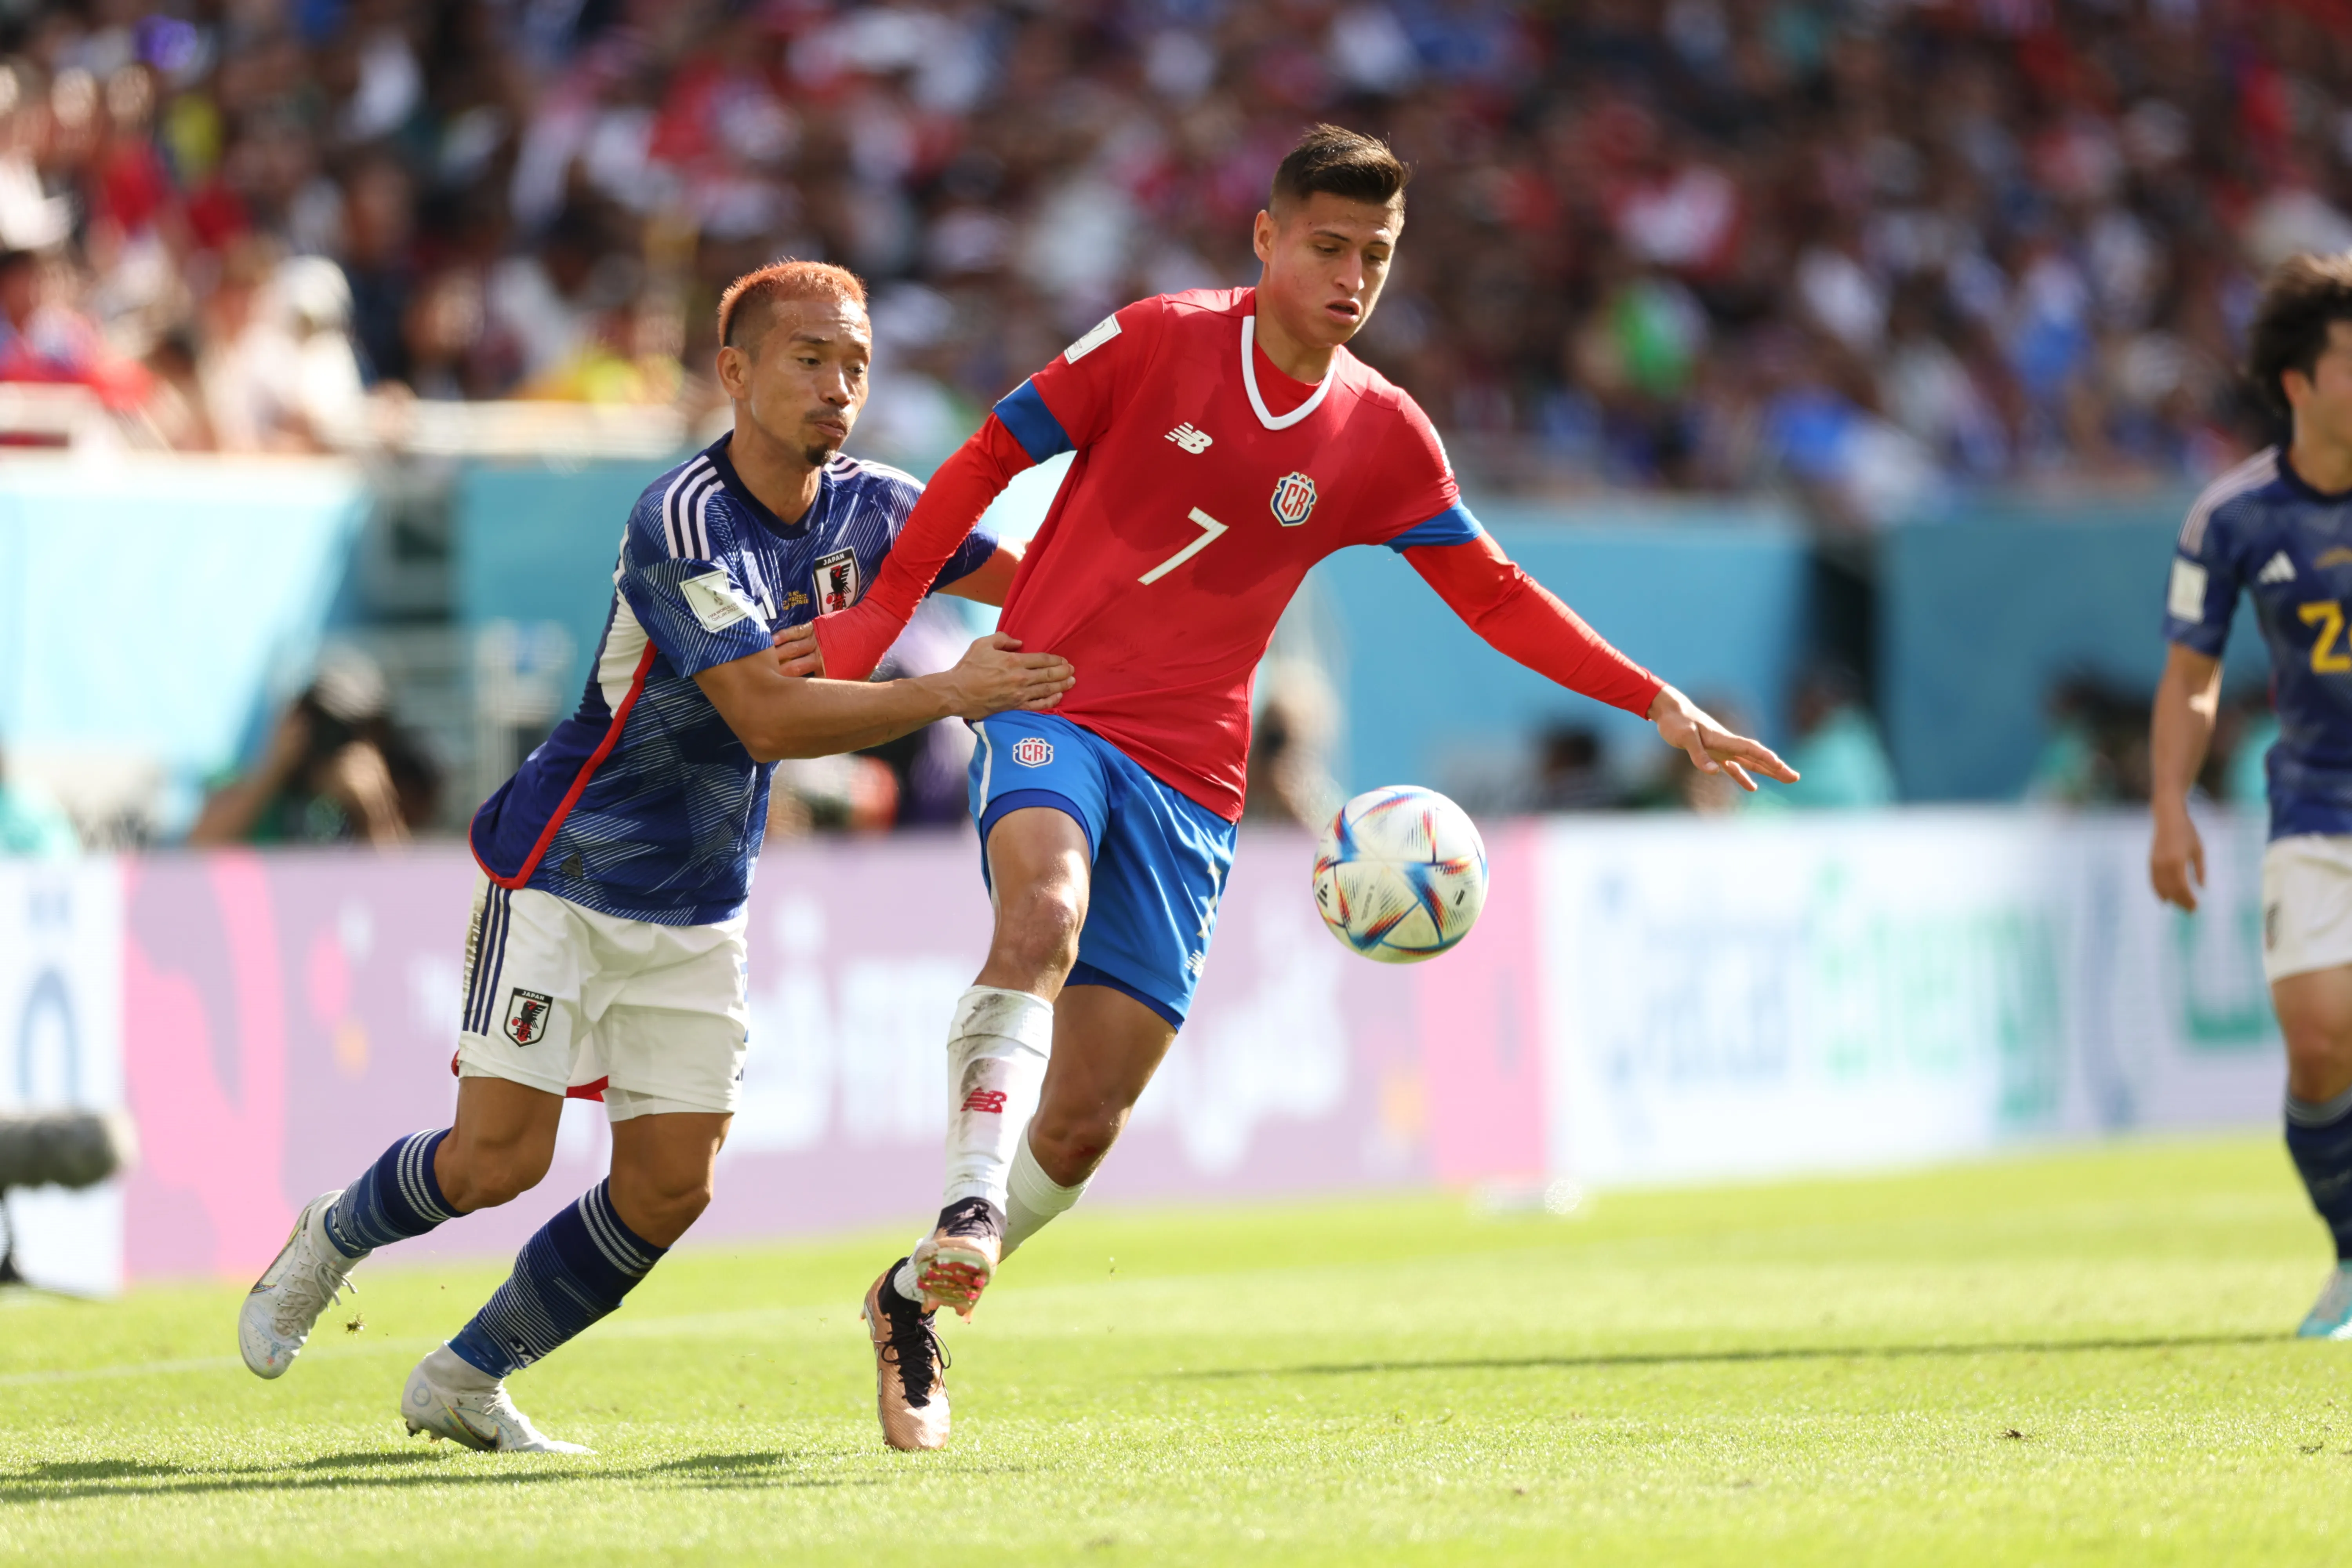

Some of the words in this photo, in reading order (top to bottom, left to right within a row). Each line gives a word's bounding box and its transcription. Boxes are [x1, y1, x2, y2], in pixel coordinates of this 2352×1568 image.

[1281, 483, 1309, 517] CR
[1137, 506, 1229, 586] 7
[823, 553, 845, 565] JAPAN
[716, 605, 731, 614] WORLD
[727, 606, 739, 614] 2022
[2297, 600, 2352, 675] 2
[1022, 744, 1044, 761] CR
[522, 991, 544, 1000] JAPAN
[513, 1027, 532, 1040] JFA
